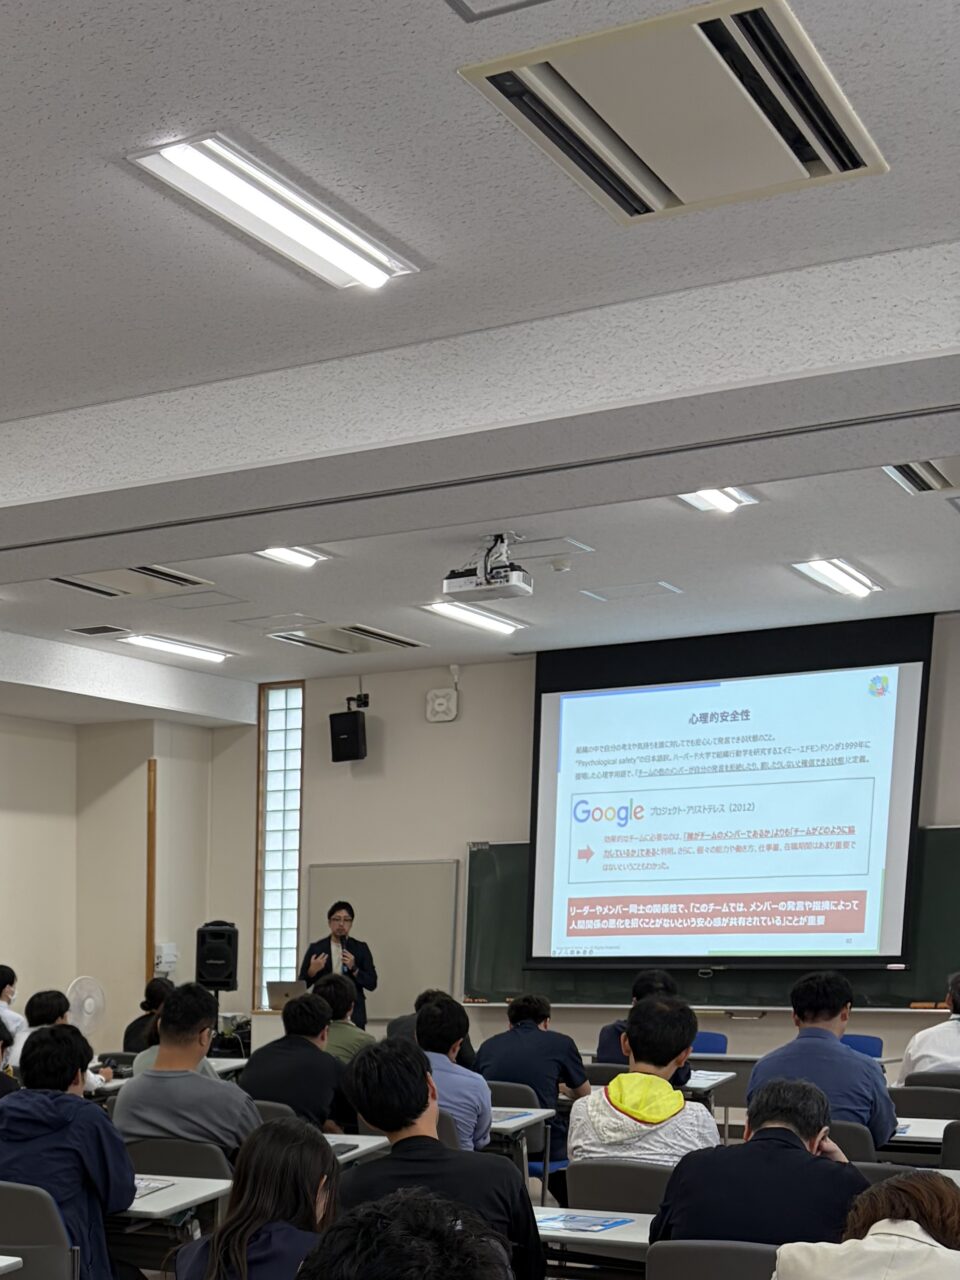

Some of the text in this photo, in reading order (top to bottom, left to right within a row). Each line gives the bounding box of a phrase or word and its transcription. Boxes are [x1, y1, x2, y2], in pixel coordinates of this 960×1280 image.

[688, 708, 751, 725] 心理的安全性
[573, 798, 645, 827] Google
